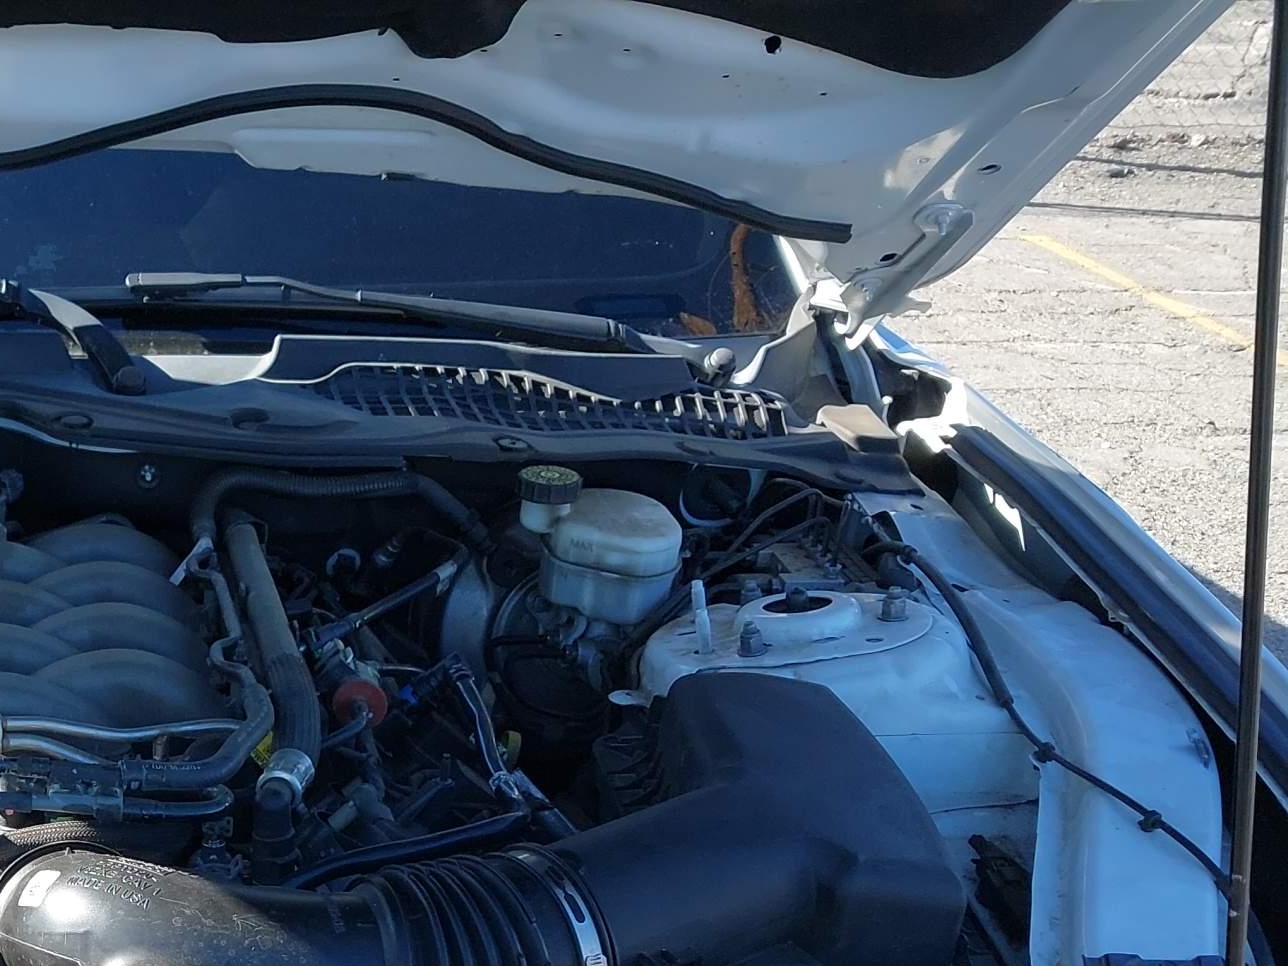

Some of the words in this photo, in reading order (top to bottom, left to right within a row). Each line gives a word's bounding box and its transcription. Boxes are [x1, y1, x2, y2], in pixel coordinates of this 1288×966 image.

[67, 877, 104, 890] MADE
[105, 884, 121, 895] IN
[121, 890, 150, 910] USA
